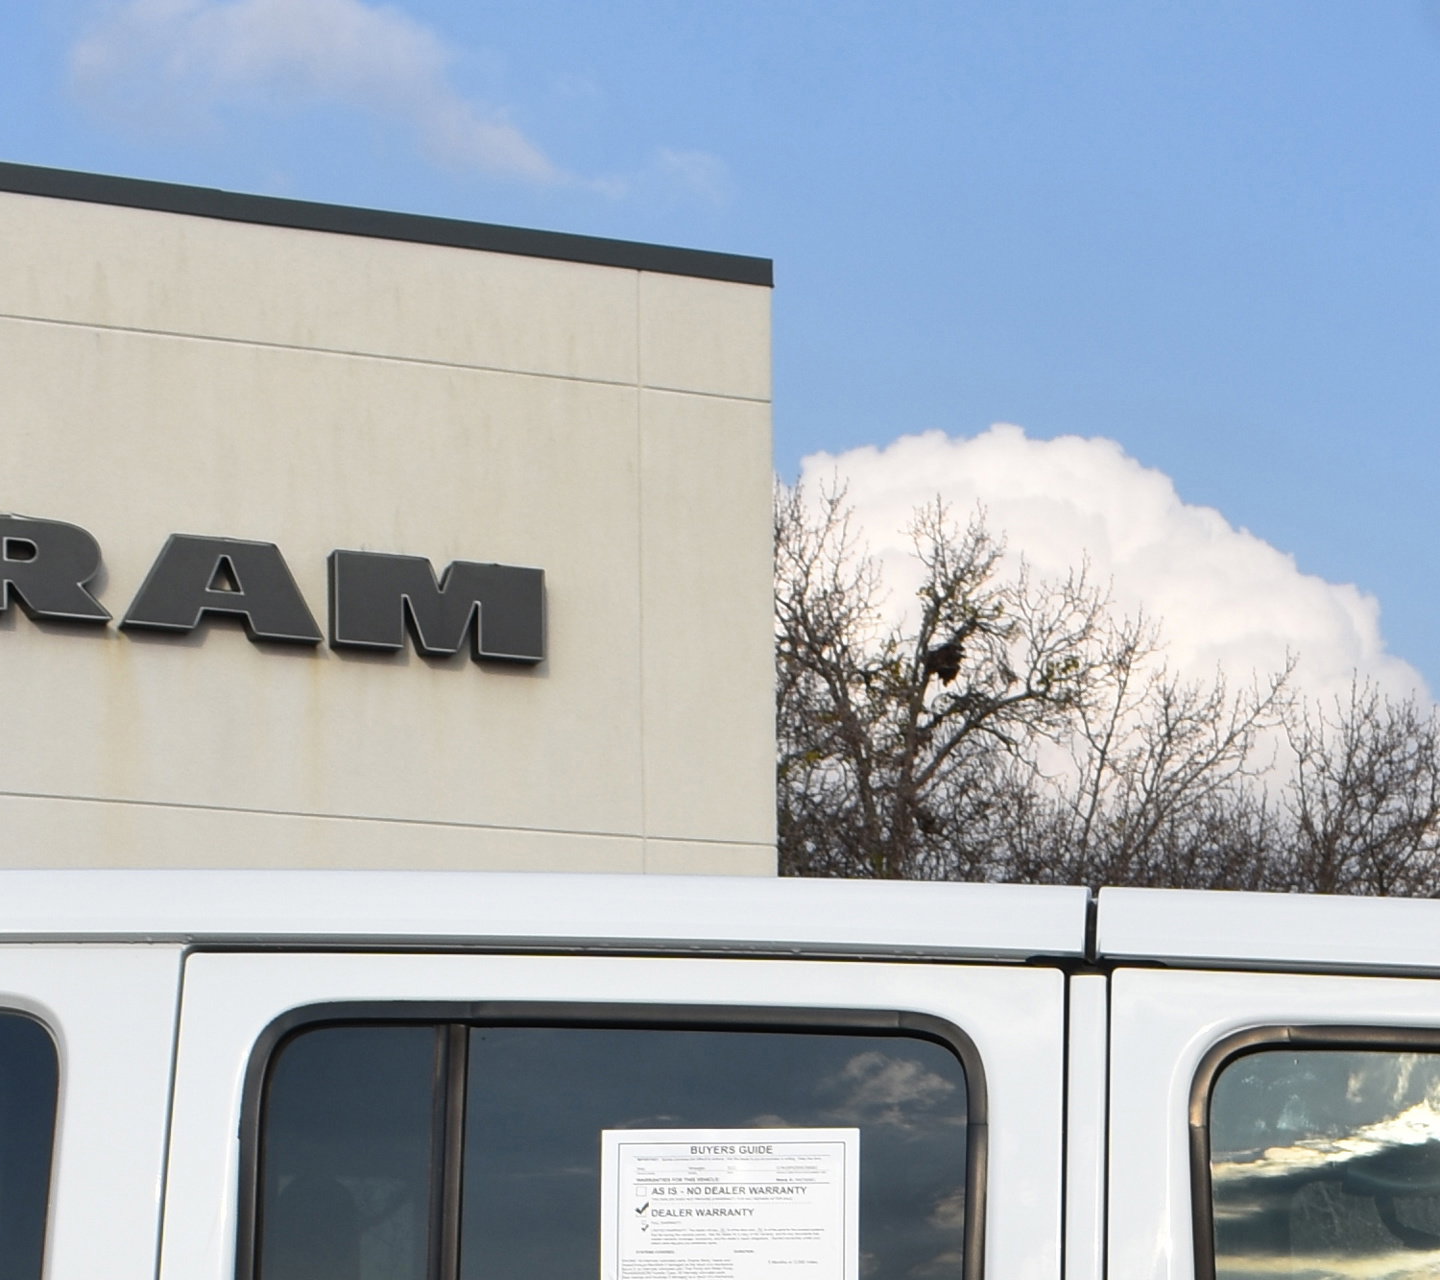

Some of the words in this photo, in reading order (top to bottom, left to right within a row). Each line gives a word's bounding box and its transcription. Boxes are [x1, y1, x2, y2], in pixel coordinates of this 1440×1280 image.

[690, 1145, 735, 1155] BUYERS
[739, 1145, 773, 1154] GUIDE
[651, 1186, 665, 1195] AS
[667, 1186, 677, 1195] IS
[686, 1186, 702, 1195] NO
[704, 1186, 746, 1195] DEALER
[748, 1186, 807, 1195] WARRANTY
[651, 1208, 692, 1217] DEALER
[695, 1208, 755, 1217] WARRANTY
